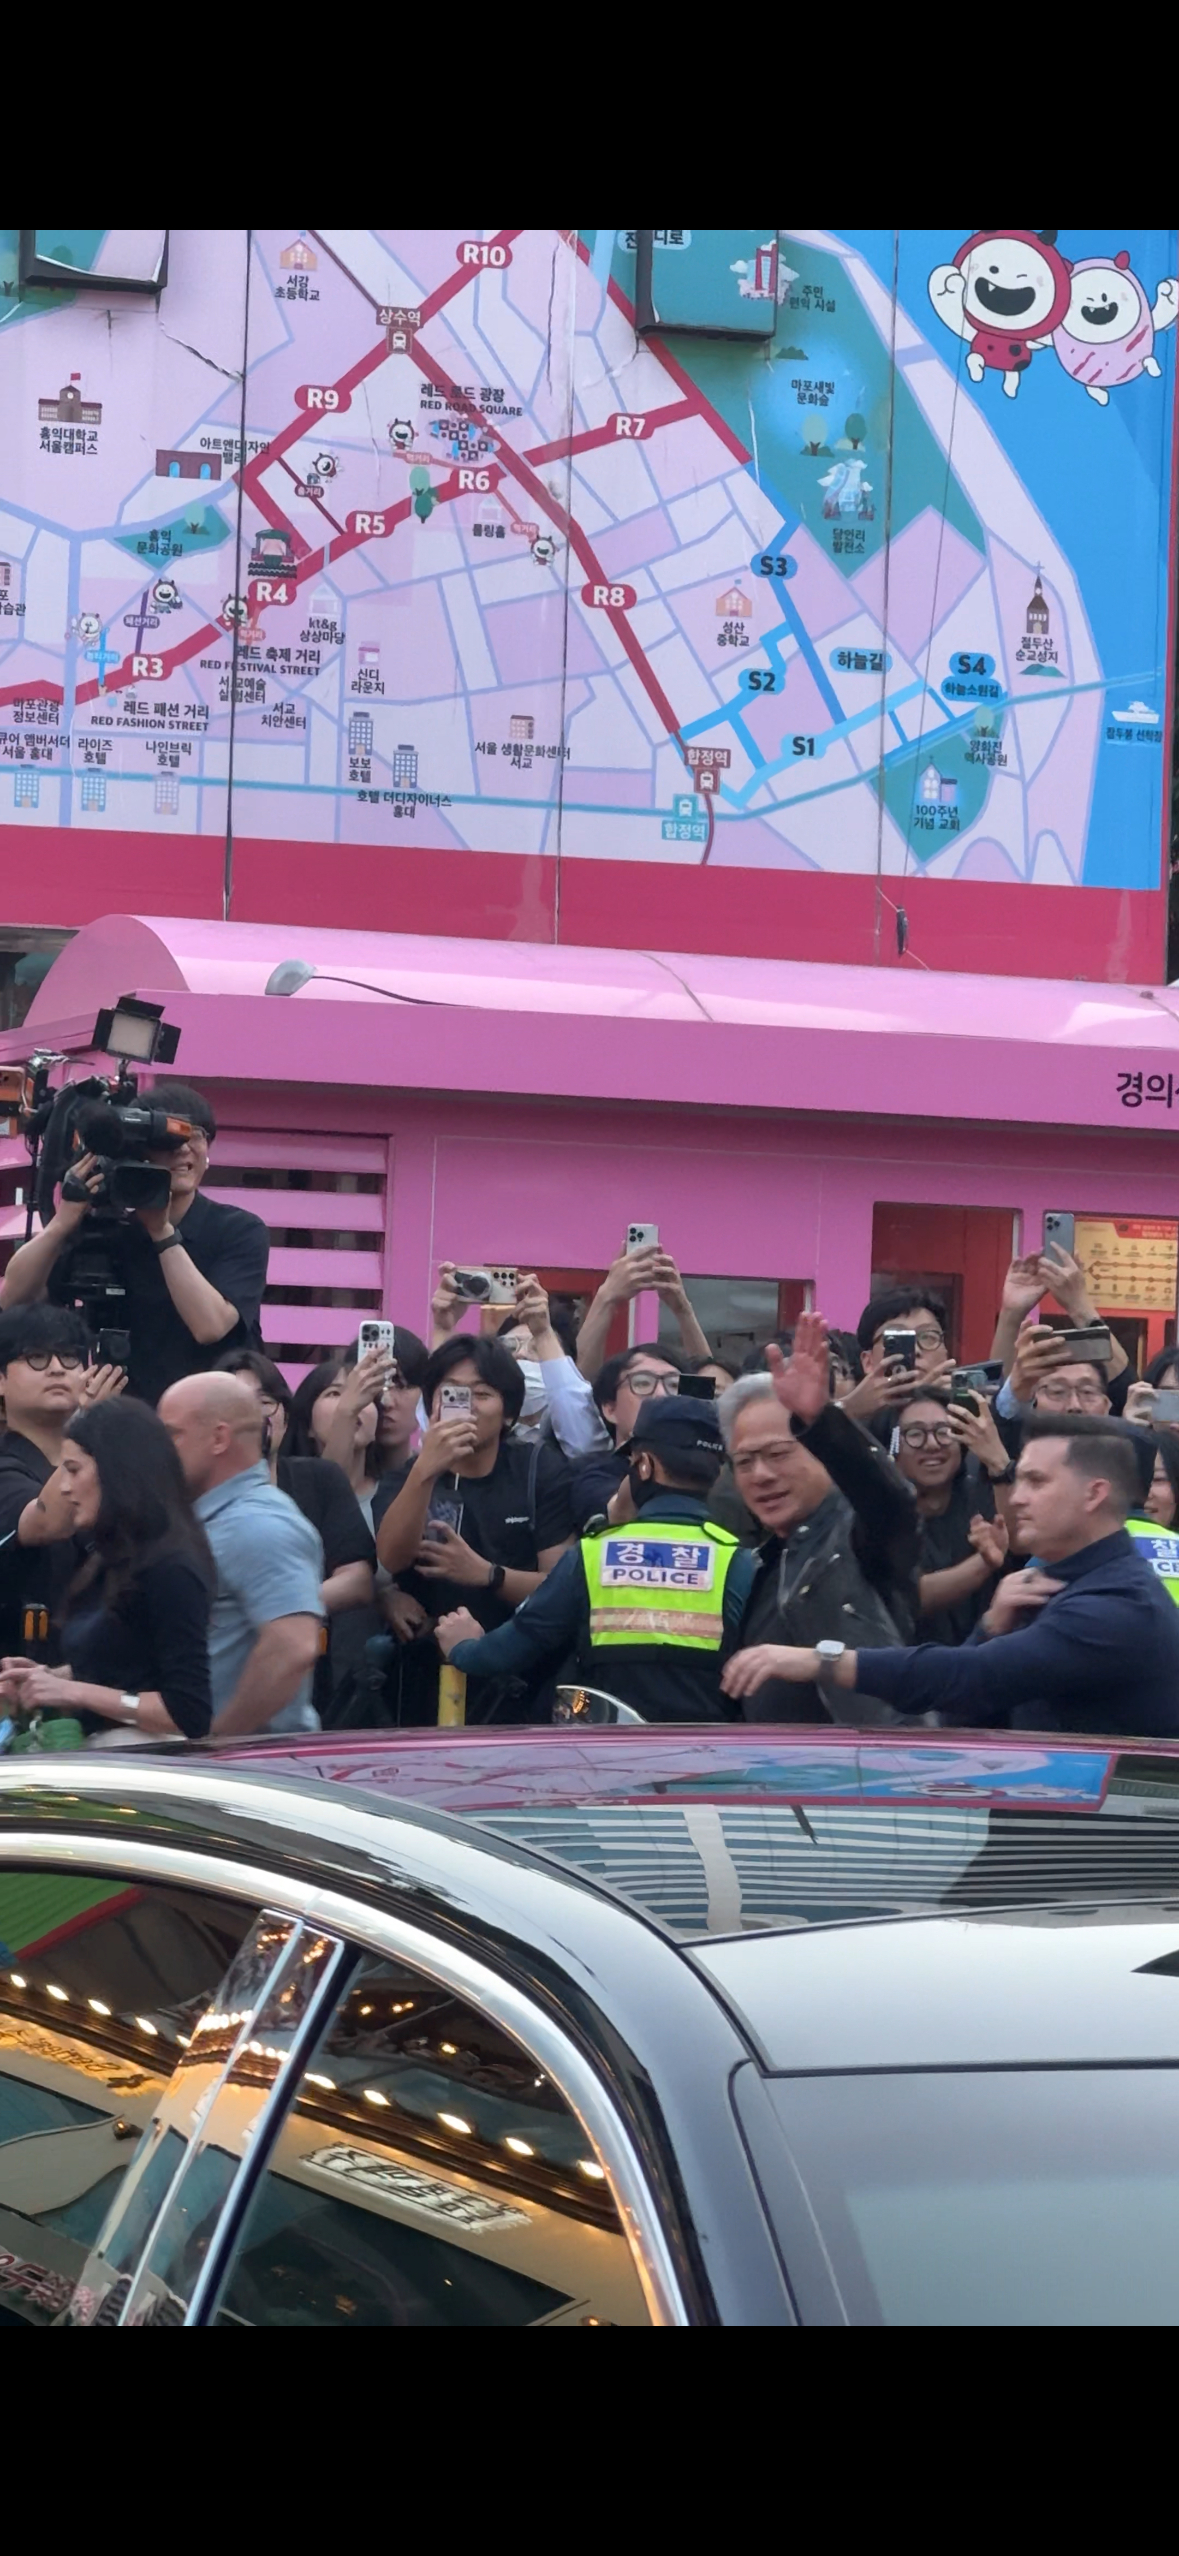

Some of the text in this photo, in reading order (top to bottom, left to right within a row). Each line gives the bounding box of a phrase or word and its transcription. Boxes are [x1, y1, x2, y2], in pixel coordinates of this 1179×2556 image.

[463, 245, 506, 266] R10
[287, 275, 309, 288] 서강
[275, 287, 320, 301] 초등학교
[803, 285, 824, 299] 주민
[815, 298, 836, 312] 시설
[379, 307, 421, 326] 상수역
[421, 384, 445, 397] 레드
[480, 387, 505, 403] 광장
[791, 379, 835, 394] 마포새빛
[307, 388, 339, 409] R9
[797, 393, 829, 407] 문화숲
[420, 400, 523, 416] RED ROAD SQUARE
[39, 426, 99, 443] 홍익대학교
[616, 417, 646, 438] R7
[39, 440, 98, 456] 서울캠퍼스
[459, 470, 490, 491] R6
[355, 514, 385, 535] R5
[149, 529, 172, 542] 홍익
[832, 528, 866, 542] 당인리
[137, 541, 183, 557] 문화공원
[832, 540, 865, 554] 발전소
[760, 556, 787, 576] S3
[257, 581, 288, 603] R4
[593, 585, 625, 607] R8
[309, 617, 337, 631] kt&g
[722, 622, 745, 635] 성산
[300, 629, 346, 645] 상상마당
[716, 633, 750, 647] 중학교
[1021, 636, 1053, 650] 절두산
[266, 646, 291, 662] 축제
[295, 649, 321, 665] 거리
[837, 651, 885, 672] 하늘길
[1015, 649, 1058, 664] 순교성지
[132, 657, 163, 678] R3
[200, 660, 221, 670] RED
[280, 665, 321, 676] STREET
[958, 655, 987, 676] S4
[357, 669, 380, 682] 신디
[748, 672, 775, 692] S2
[351, 680, 386, 695] 라운지
[945, 682, 1000, 699] 하늘소원길
[13, 697, 60, 713] 마포관광
[123, 701, 210, 719] 레드 패션 거리
[272, 702, 295, 715] 서교
[13, 710, 60, 726] 정보센터
[91, 716, 209, 732] RED FASHION STREET
[261, 714, 307, 730] 치안센터
[2, 745, 53, 761] 서울 홍대
[78, 738, 113, 752] 라이즈
[146, 741, 192, 756] 나인브릭
[474, 741, 497, 756] 서울
[792, 736, 815, 757] S1
[970, 740, 1003, 753] 양화진
[83, 751, 107, 765] 호텔
[157, 754, 180, 768] 호텔
[349, 758, 371, 770] 보보
[510, 757, 533, 770] 서교
[687, 749, 729, 768] 합정역
[964, 752, 1008, 767] 역사공원
[348, 770, 372, 783] 호텔
[357, 790, 453, 808] 호텔 더디자이너스
[393, 806, 416, 819] 홍대
[916, 805, 959, 819] 100주년
[665, 822, 706, 841] 합정역
[914, 818, 961, 831] 기념 교회
[1116, 1072, 1179, 1109] 경의
[697, 1440, 724, 1451] POLICE
[613, 1568, 699, 1585] POLICE
